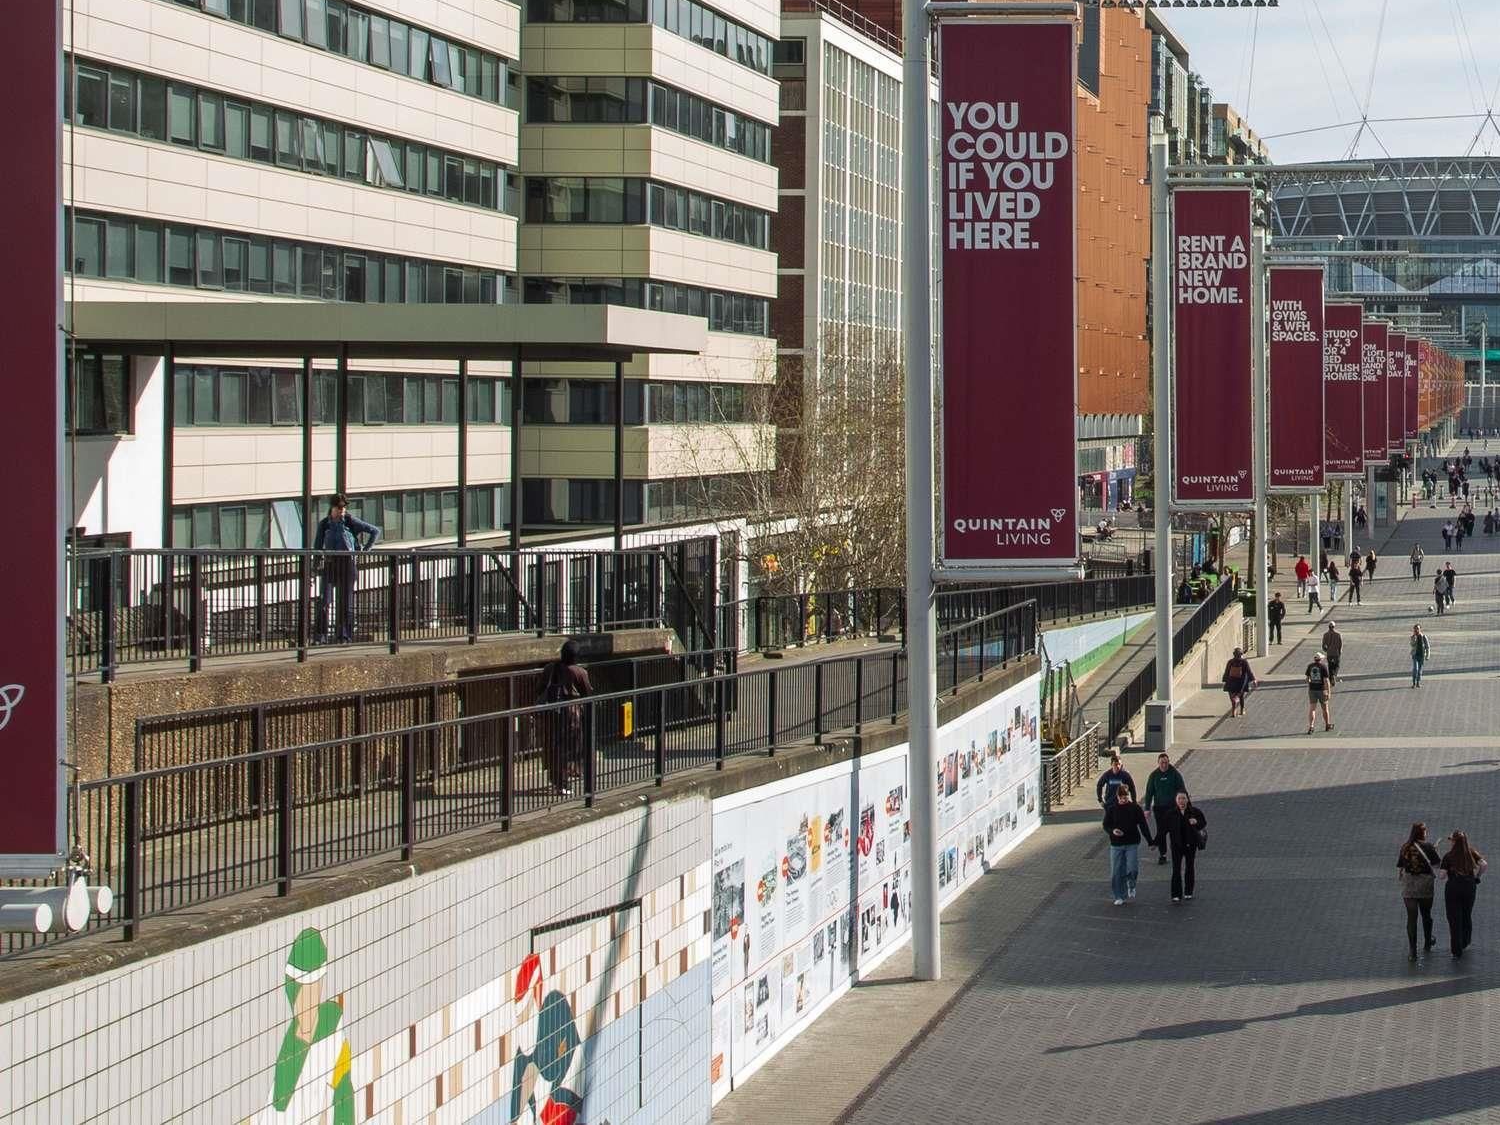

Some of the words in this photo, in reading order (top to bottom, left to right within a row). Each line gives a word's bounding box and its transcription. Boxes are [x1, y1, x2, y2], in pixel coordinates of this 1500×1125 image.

[947, 101, 1019, 130] YOU
[947, 131, 1069, 160] COULD
[948, 162, 975, 190] IF
[982, 161, 1054, 190] YOU
[948, 191, 1041, 220] LIVED
[949, 221, 1040, 250] HERE.
[1178, 235, 1226, 252] RENT
[1230, 235, 1246, 252] A
[1178, 253, 1248, 269] BRAND
[1178, 270, 1223, 286] NEW
[1178, 287, 1243, 304] HOME.
[1272, 300, 1302, 311] WITH
[1272, 311, 1308, 321] GYMS
[1272, 321, 1281, 331] &
[1284, 321, 1310, 331] WFH
[1272, 331, 1320, 342] SPACES.
[1323, 329, 1358, 339] STUDIO
[1345, 339, 1351, 347] 3
[1323, 347, 1338, 355] OR
[1340, 347, 1347, 355] 4
[1323, 355, 1342, 364] BED
[1323, 363, 1360, 372] STYLISH
[1323, 372, 1361, 381] HOMES.
[1274, 468, 1315, 476] QUINTAIN
[1182, 475, 1239, 485] QUINTAIN
[1206, 484, 1239, 492] LIVING
[953, 518, 1051, 533] QUINTAIN
[996, 532, 1051, 545] LIVING
